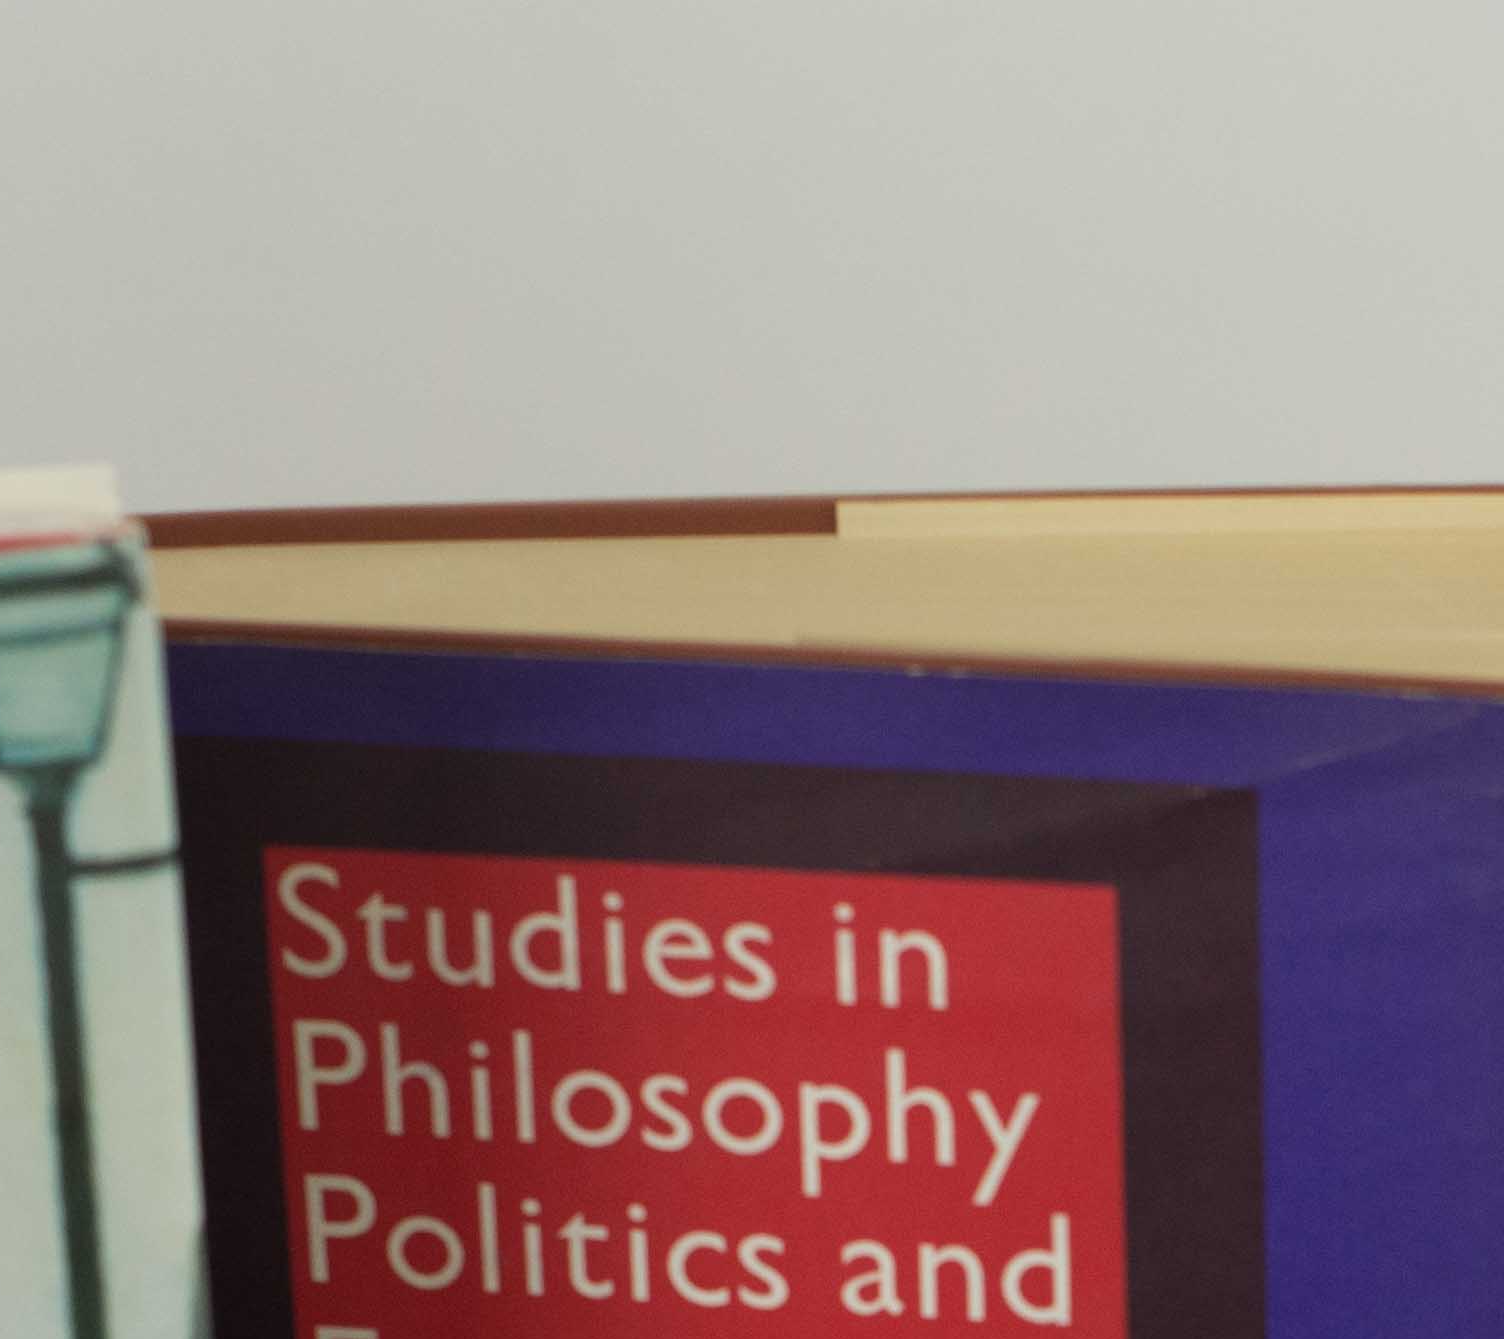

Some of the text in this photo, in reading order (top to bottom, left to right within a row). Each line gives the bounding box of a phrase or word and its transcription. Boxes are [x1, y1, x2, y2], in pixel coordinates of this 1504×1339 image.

[277, 861, 949, 1011] Studies in
[293, 1018, 1041, 1206] Philosophy
[303, 1172, 1072, 1327] Politics and
